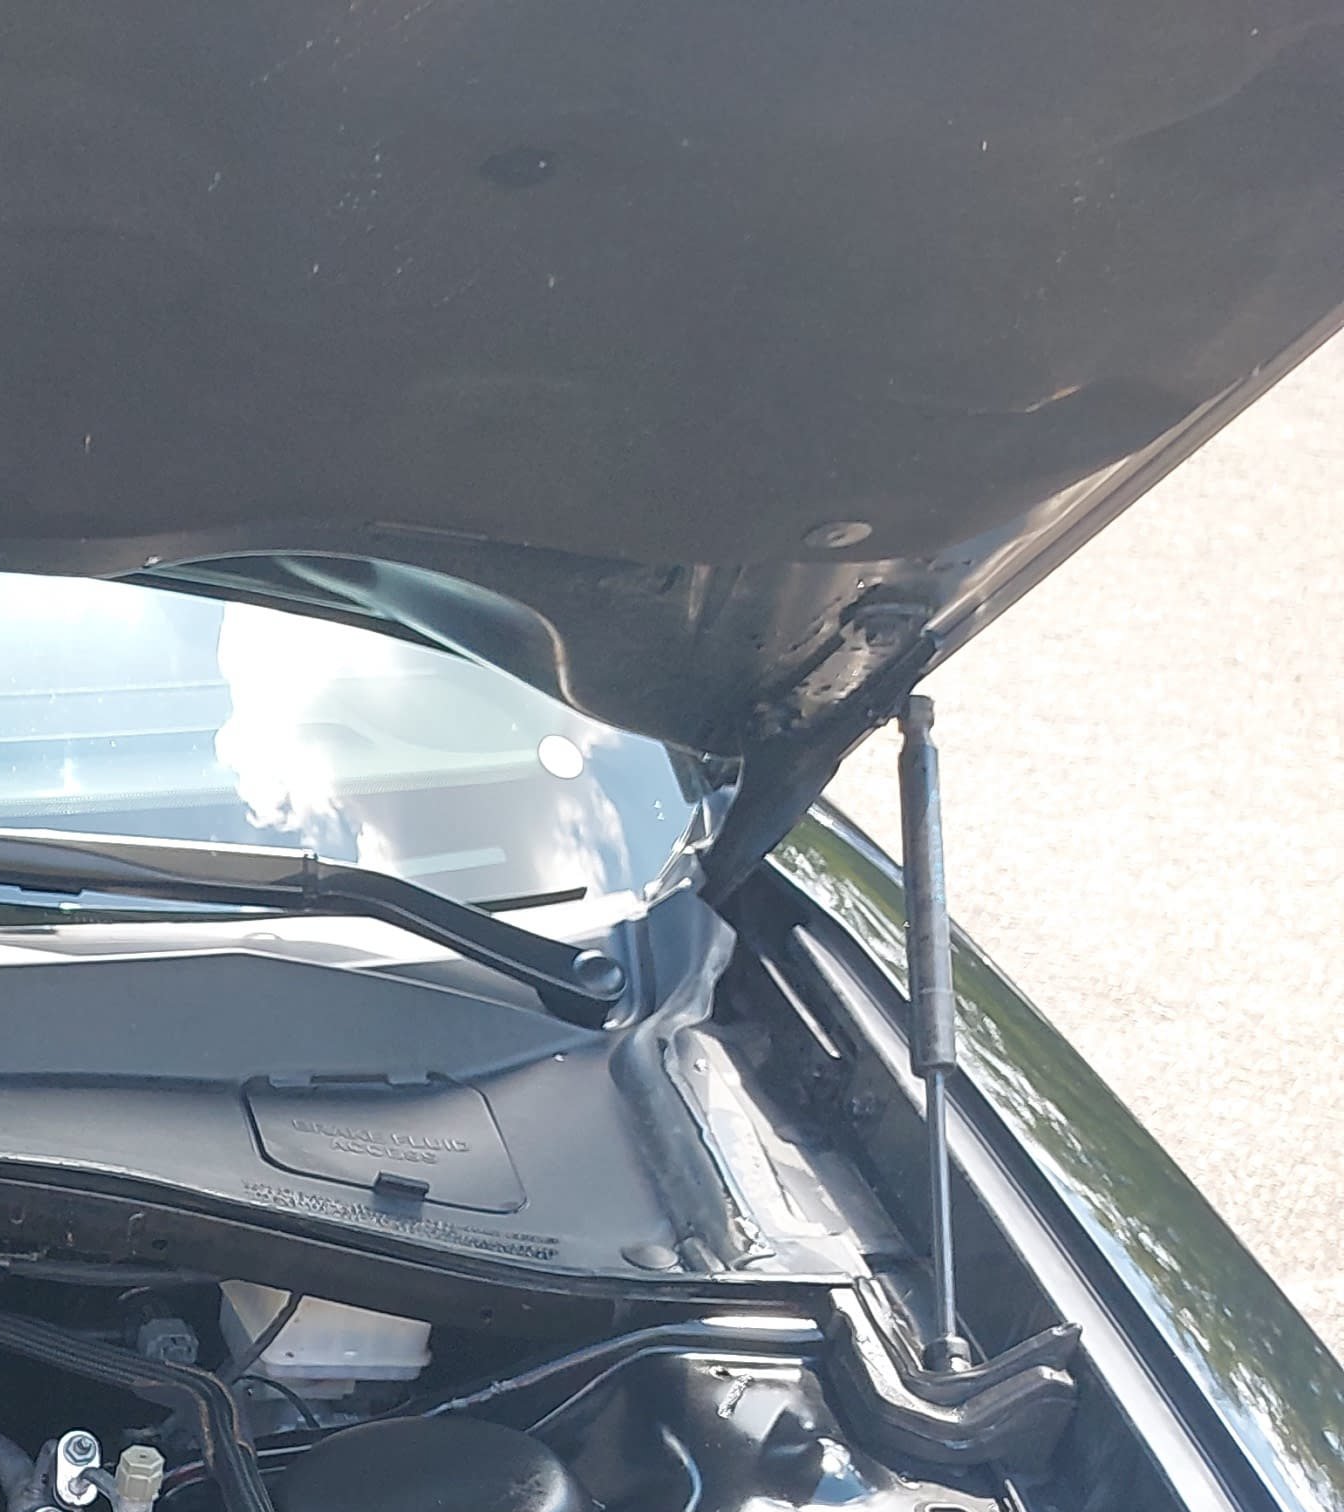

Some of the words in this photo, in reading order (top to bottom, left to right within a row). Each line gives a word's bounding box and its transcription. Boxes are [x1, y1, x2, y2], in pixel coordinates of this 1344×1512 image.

[292, 1119, 376, 1144] BRAKE
[391, 1133, 471, 1153] FLUID
[333, 1139, 437, 1165] ACCESS
